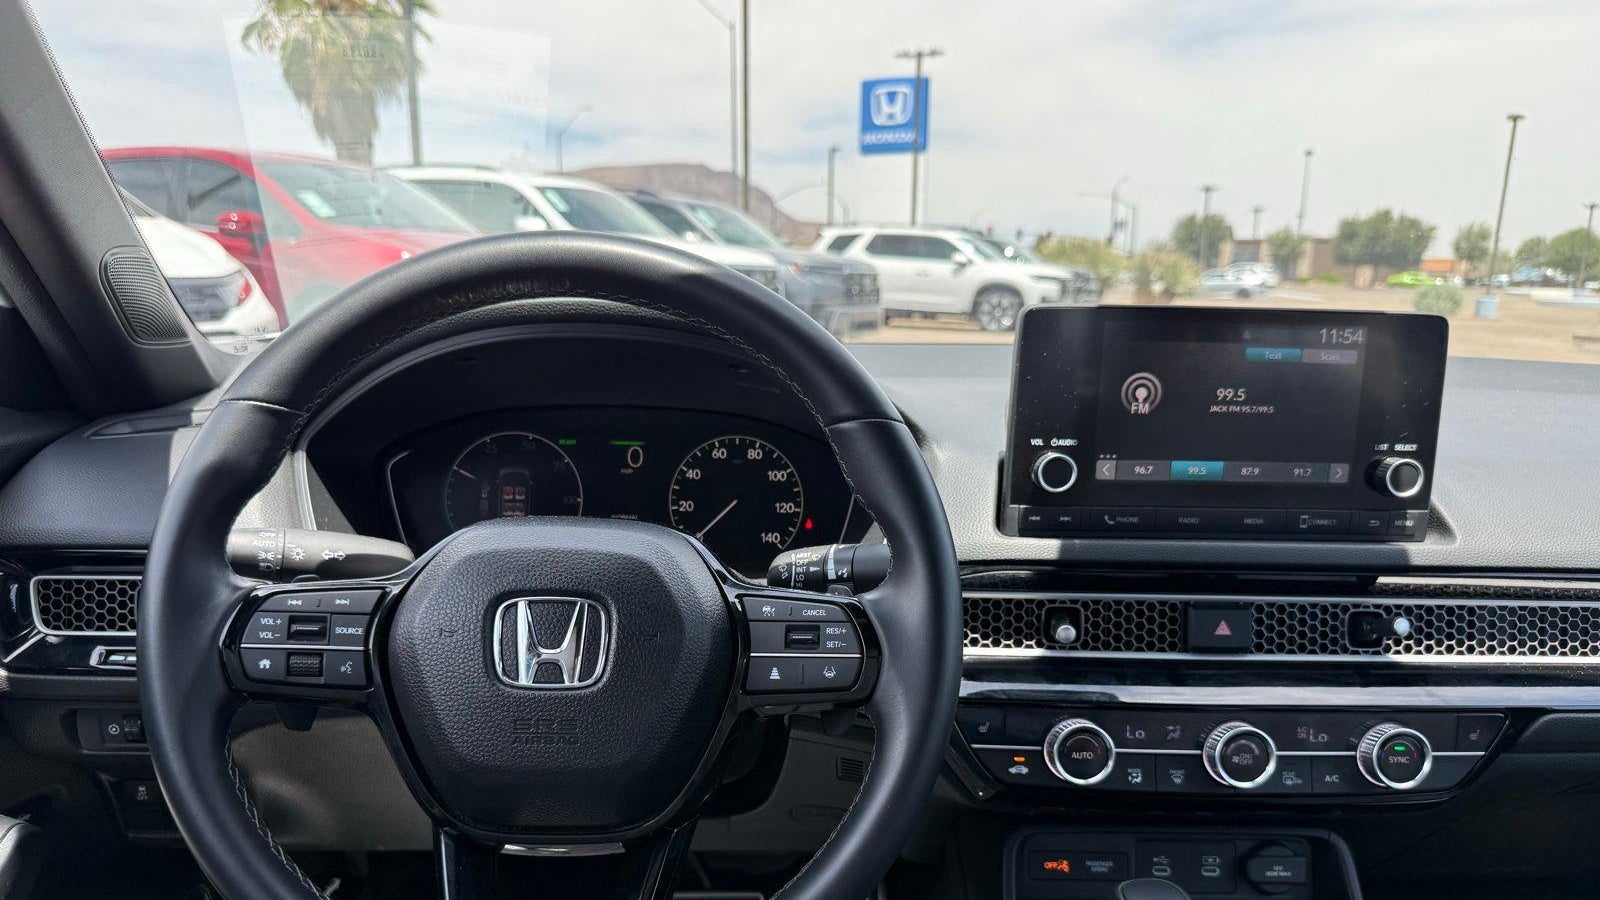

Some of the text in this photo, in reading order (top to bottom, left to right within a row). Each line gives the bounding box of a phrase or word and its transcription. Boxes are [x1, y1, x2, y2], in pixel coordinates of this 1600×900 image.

[1319, 327, 1365, 345] 11:54
[1264, 350, 1283, 360] Text
[1215, 388, 1247, 402] 99.5
[1130, 402, 1149, 415] FM
[1209, 405, 1227, 413] JACK
[1241, 406, 1274, 414] 95.7/99.5
[1030, 438, 1044, 446] VOL
[1058, 438, 1078, 446] AUDIO
[1374, 443, 1389, 451] LIST
[1394, 443, 1418, 451] SELECT
[627, 446, 643, 468] 0
[711, 448, 727, 459] 60
[747, 448, 763, 460] 80
[685, 469, 701, 480] 40
[1134, 465, 1153, 475] 96.7
[1187, 466, 1206, 475] 99.5
[1240, 467, 1259, 476] 87.9
[1293, 468, 1312, 477] 91.7
[767, 471, 787, 481] 100
[679, 501, 694, 511] 20
[774, 502, 795, 513] 120
[1178, 516, 1200, 524] RADIO
[1243, 517, 1264, 525] MEDIA
[1308, 518, 1337, 526] CONNECT
[760, 532, 781, 543] 140
[252, 540, 276, 548] AUTO
[260, 617, 282, 625] VOL+
[259, 631, 281, 639] VOL-
[335, 627, 363, 635] SOURCE
[826, 627, 847, 635] RES/+
[1071, 751, 1093, 759] AUTO
[1388, 755, 1410, 764] SYNC
[1324, 774, 1341, 782] A/C
[1043, 861, 1058, 869] OFF
